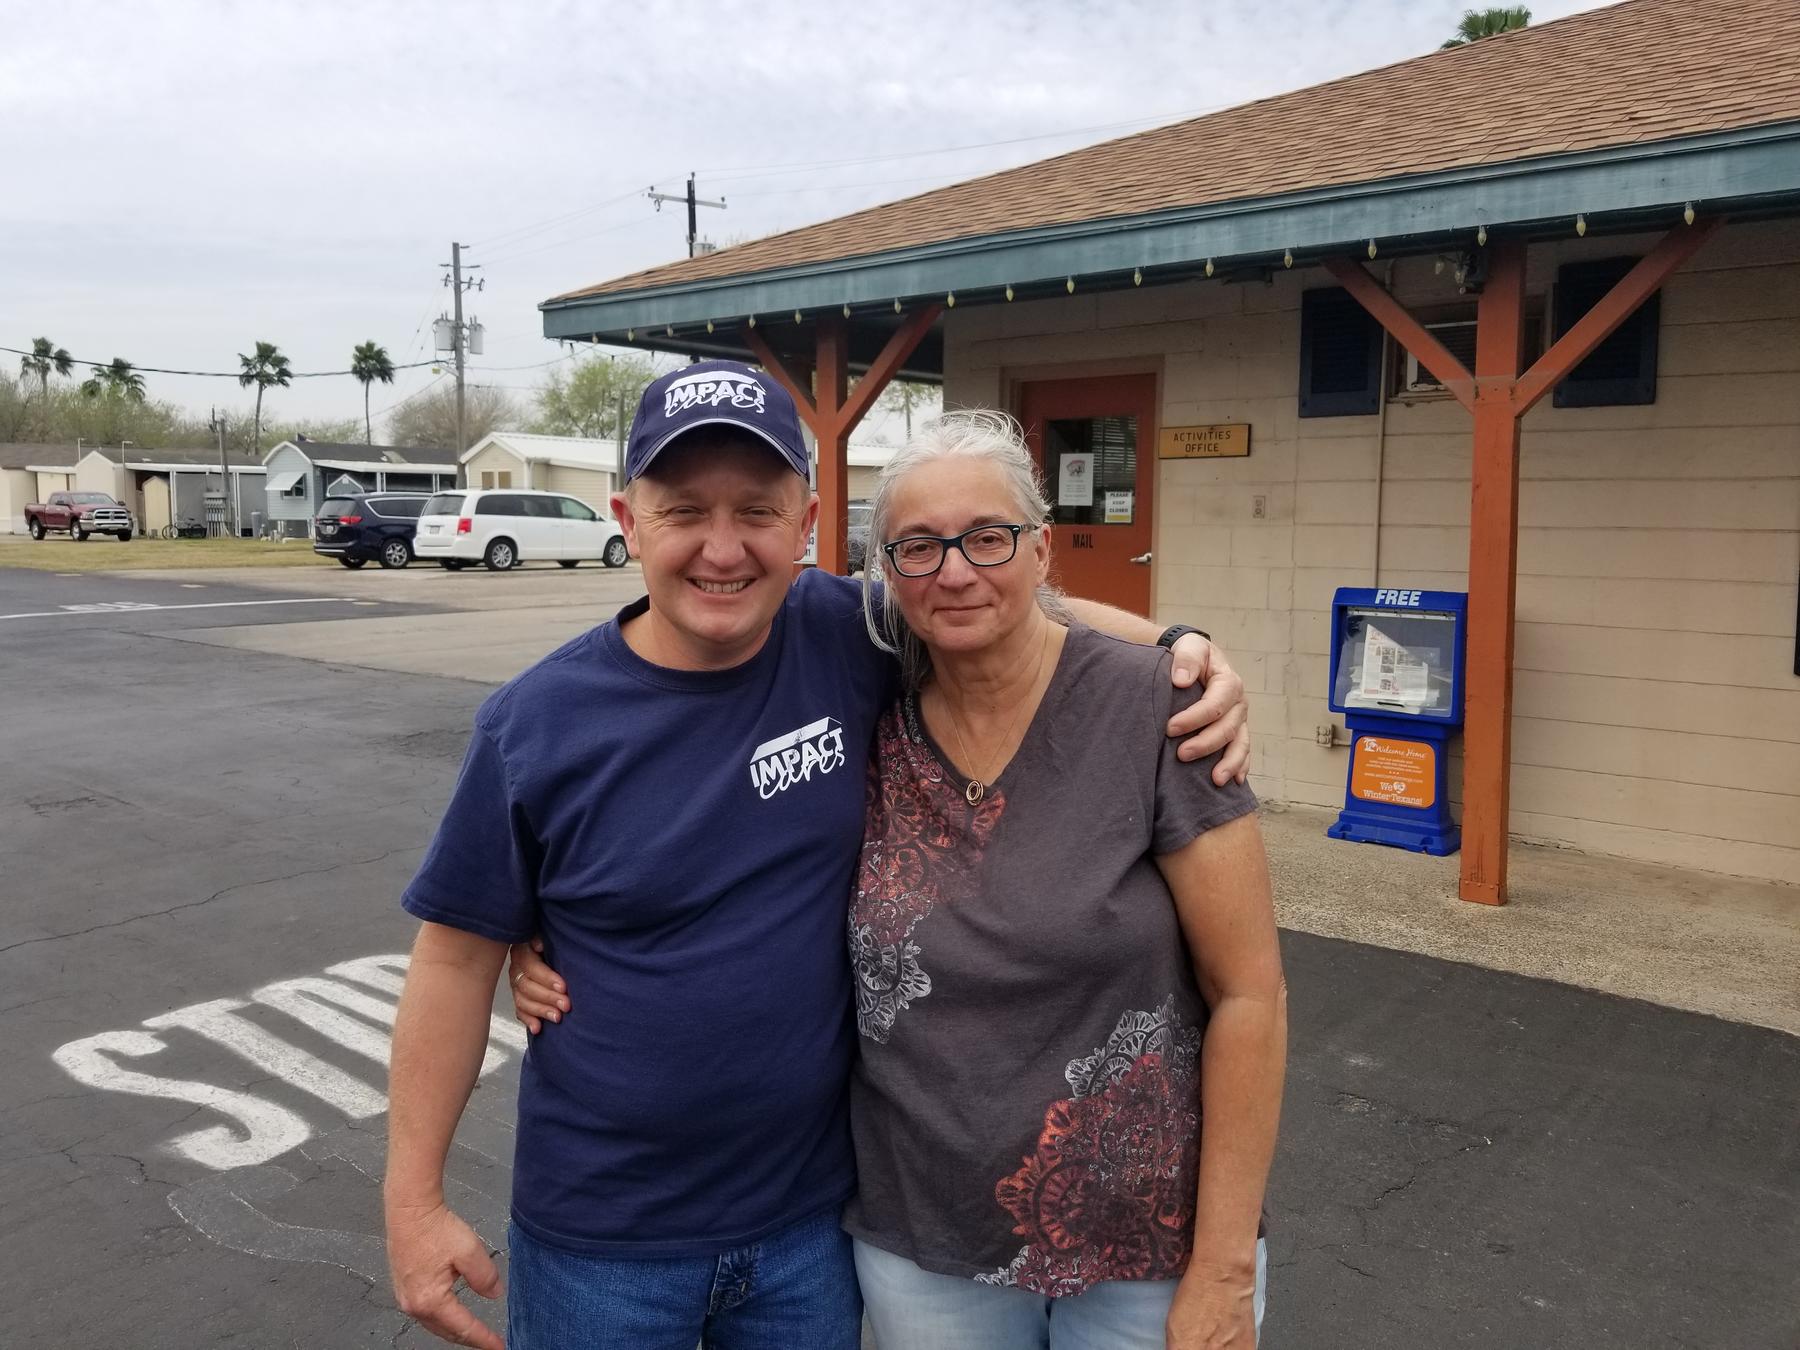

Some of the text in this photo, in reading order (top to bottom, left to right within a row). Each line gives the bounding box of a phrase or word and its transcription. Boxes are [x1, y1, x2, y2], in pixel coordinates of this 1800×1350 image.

[664, 381, 766, 410] IMPACT
[1173, 430, 1232, 442] ACTIVITIES
[1185, 443, 1219, 453] OFFICE
[1072, 533, 1094, 549] MAIL
[1375, 589, 1422, 606] FREE
[749, 727, 844, 788] IMPACT
[1376, 745, 1405, 756] Welcome
[1405, 748, 1425, 760] Home
[1380, 782, 1393, 792] We
[1363, 789, 1391, 801] Winter
